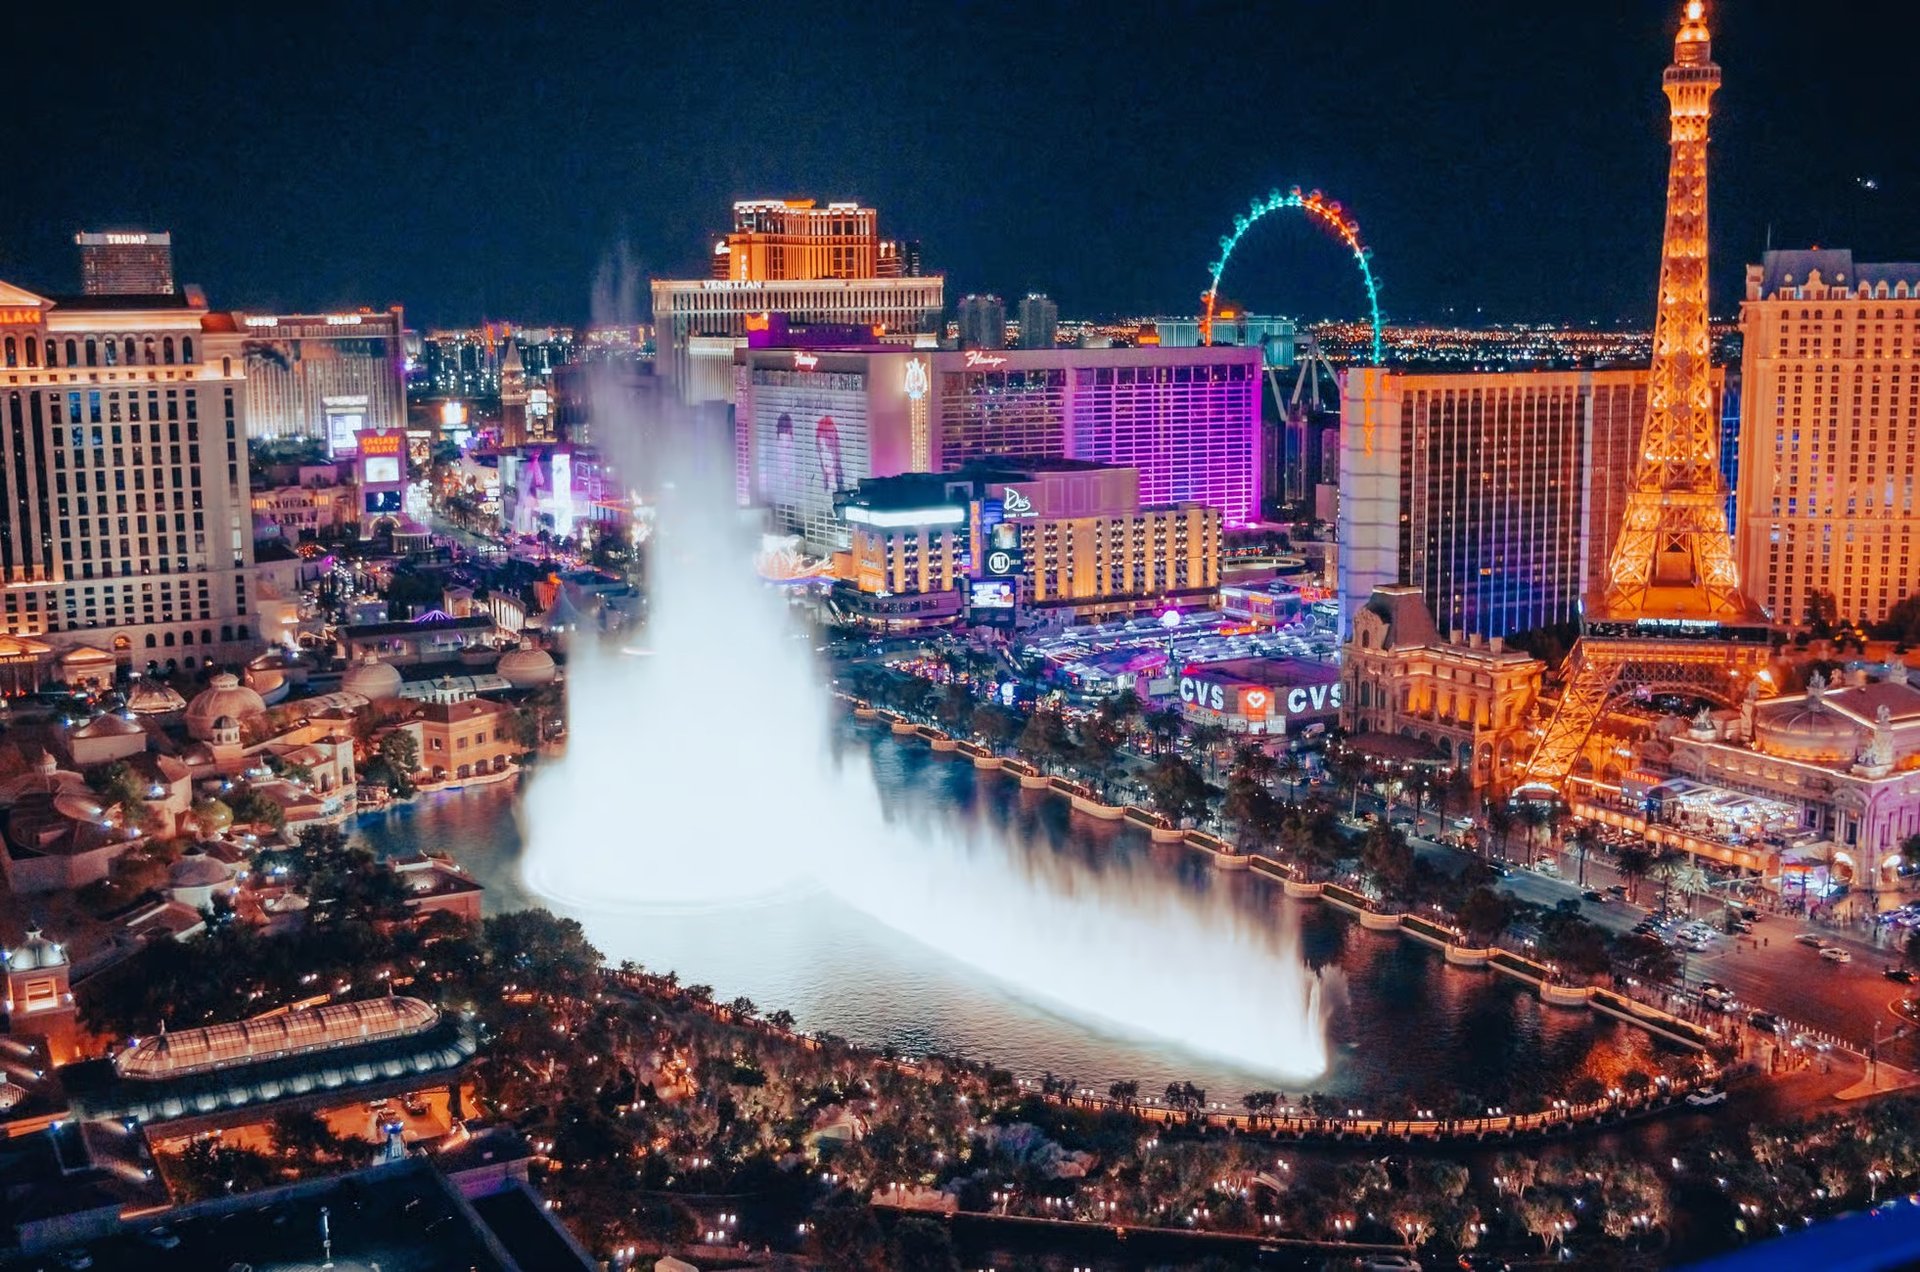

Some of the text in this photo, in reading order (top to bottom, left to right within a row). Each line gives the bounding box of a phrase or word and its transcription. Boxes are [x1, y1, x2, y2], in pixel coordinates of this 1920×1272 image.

[106, 234, 147, 244] TRUMP
[703, 281, 762, 289] VENETIAN
[0, 310, 41, 323] LACE
[965, 351, 1007, 367] Flamingo
[364, 444, 398, 454] PALACE
[1659, 618, 1680, 626] TOWER
[1681, 619, 1719, 627] RESTAURANT
[1180, 677, 1224, 710] CVS
[1288, 683, 1341, 713] CVS
